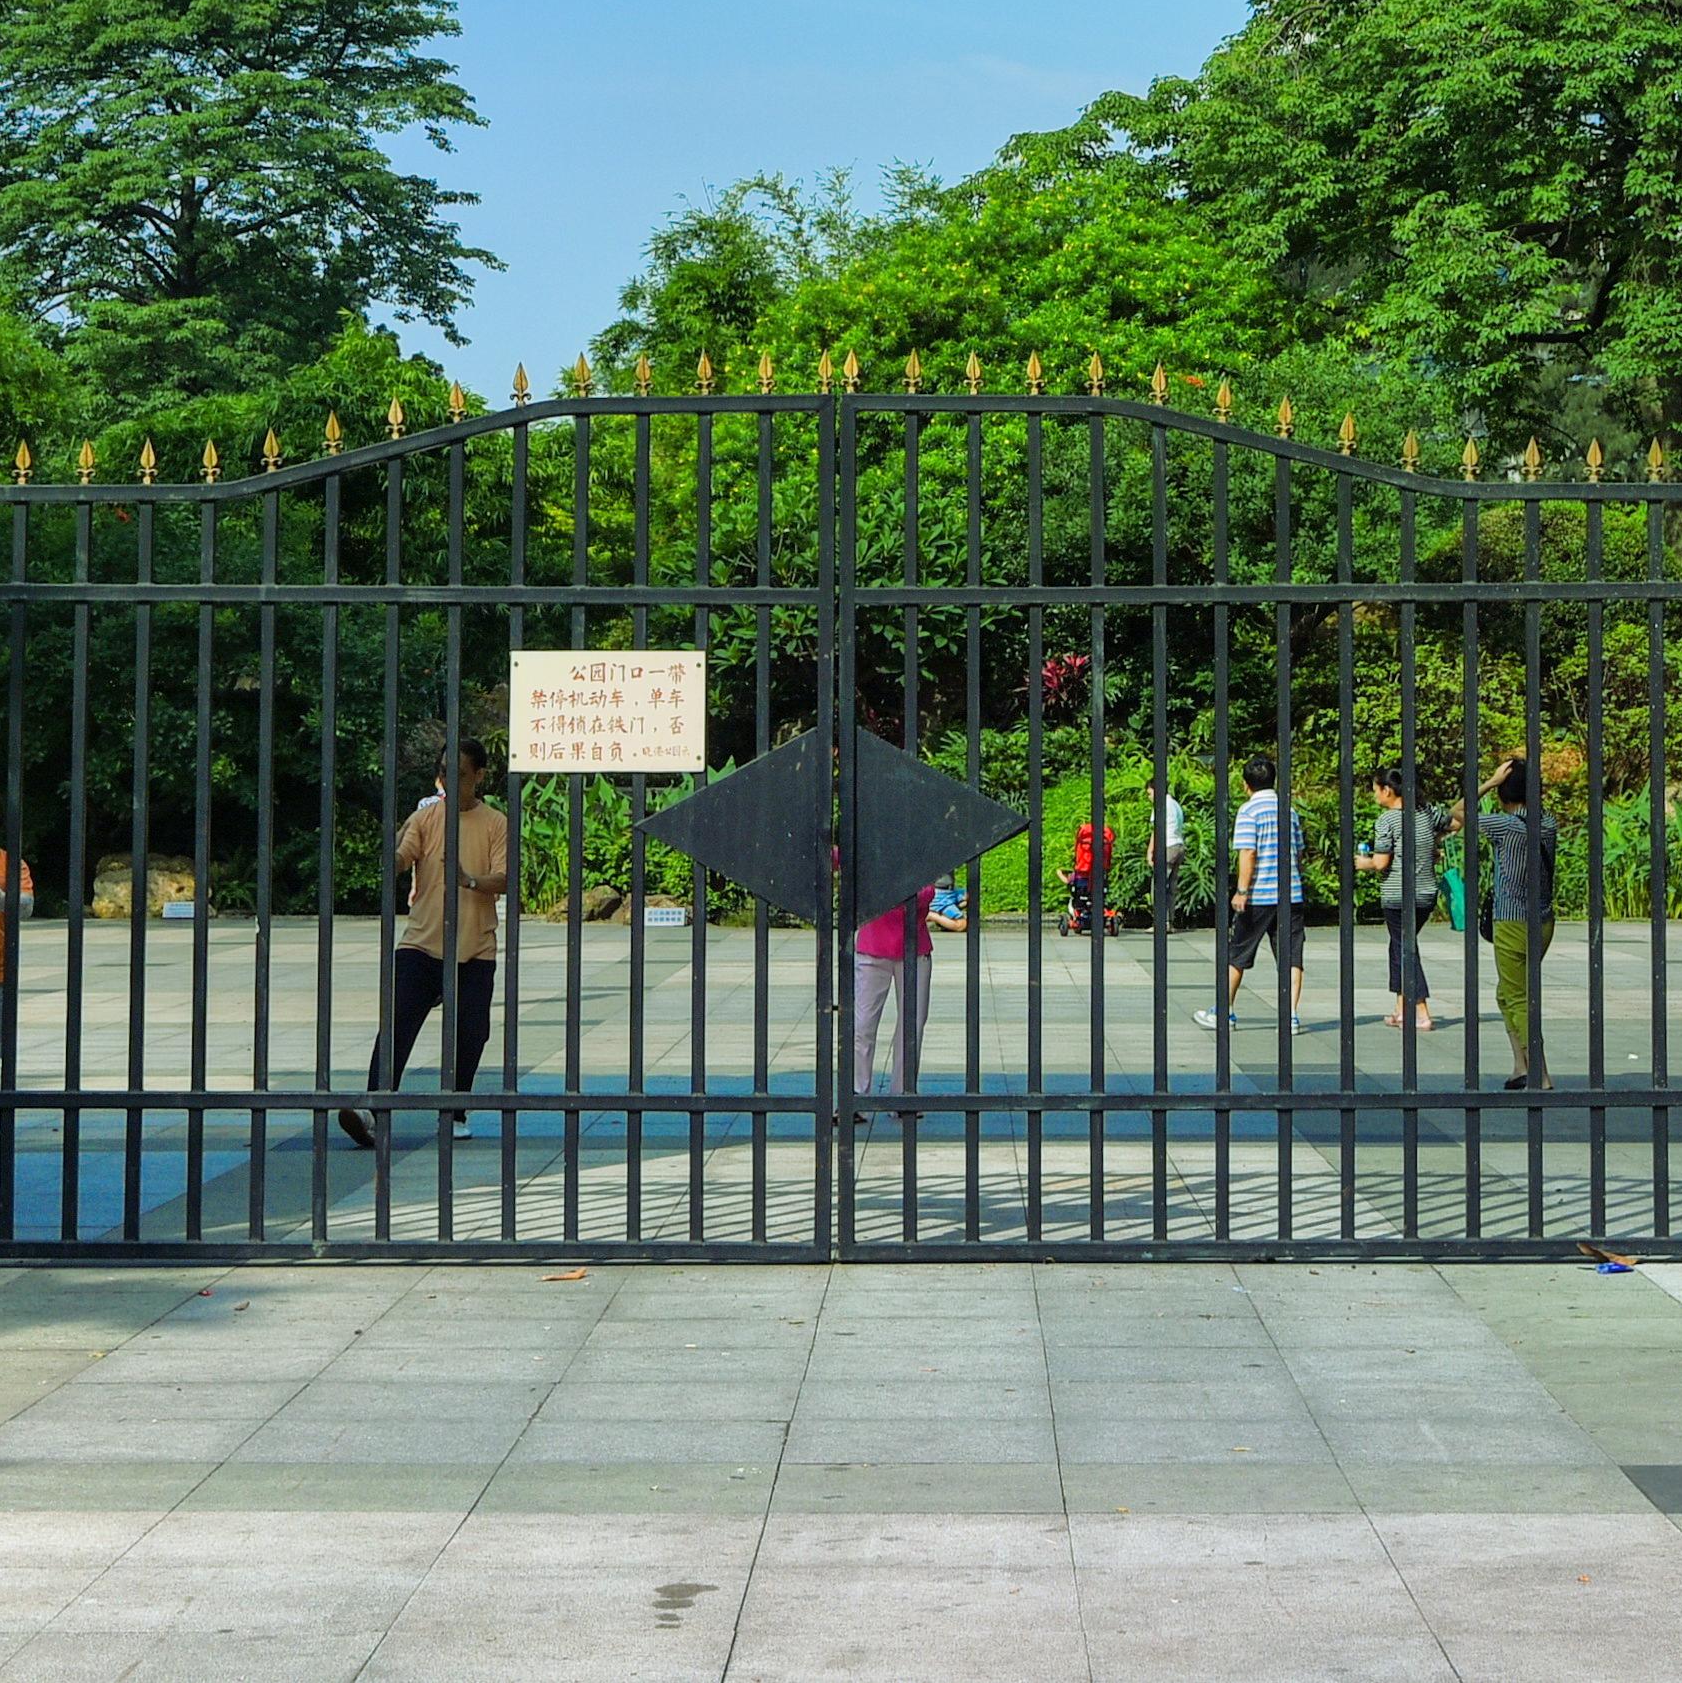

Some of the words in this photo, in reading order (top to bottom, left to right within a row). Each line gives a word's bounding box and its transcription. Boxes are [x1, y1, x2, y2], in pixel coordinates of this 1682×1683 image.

[569, 662, 686, 684] 公园门口一带
